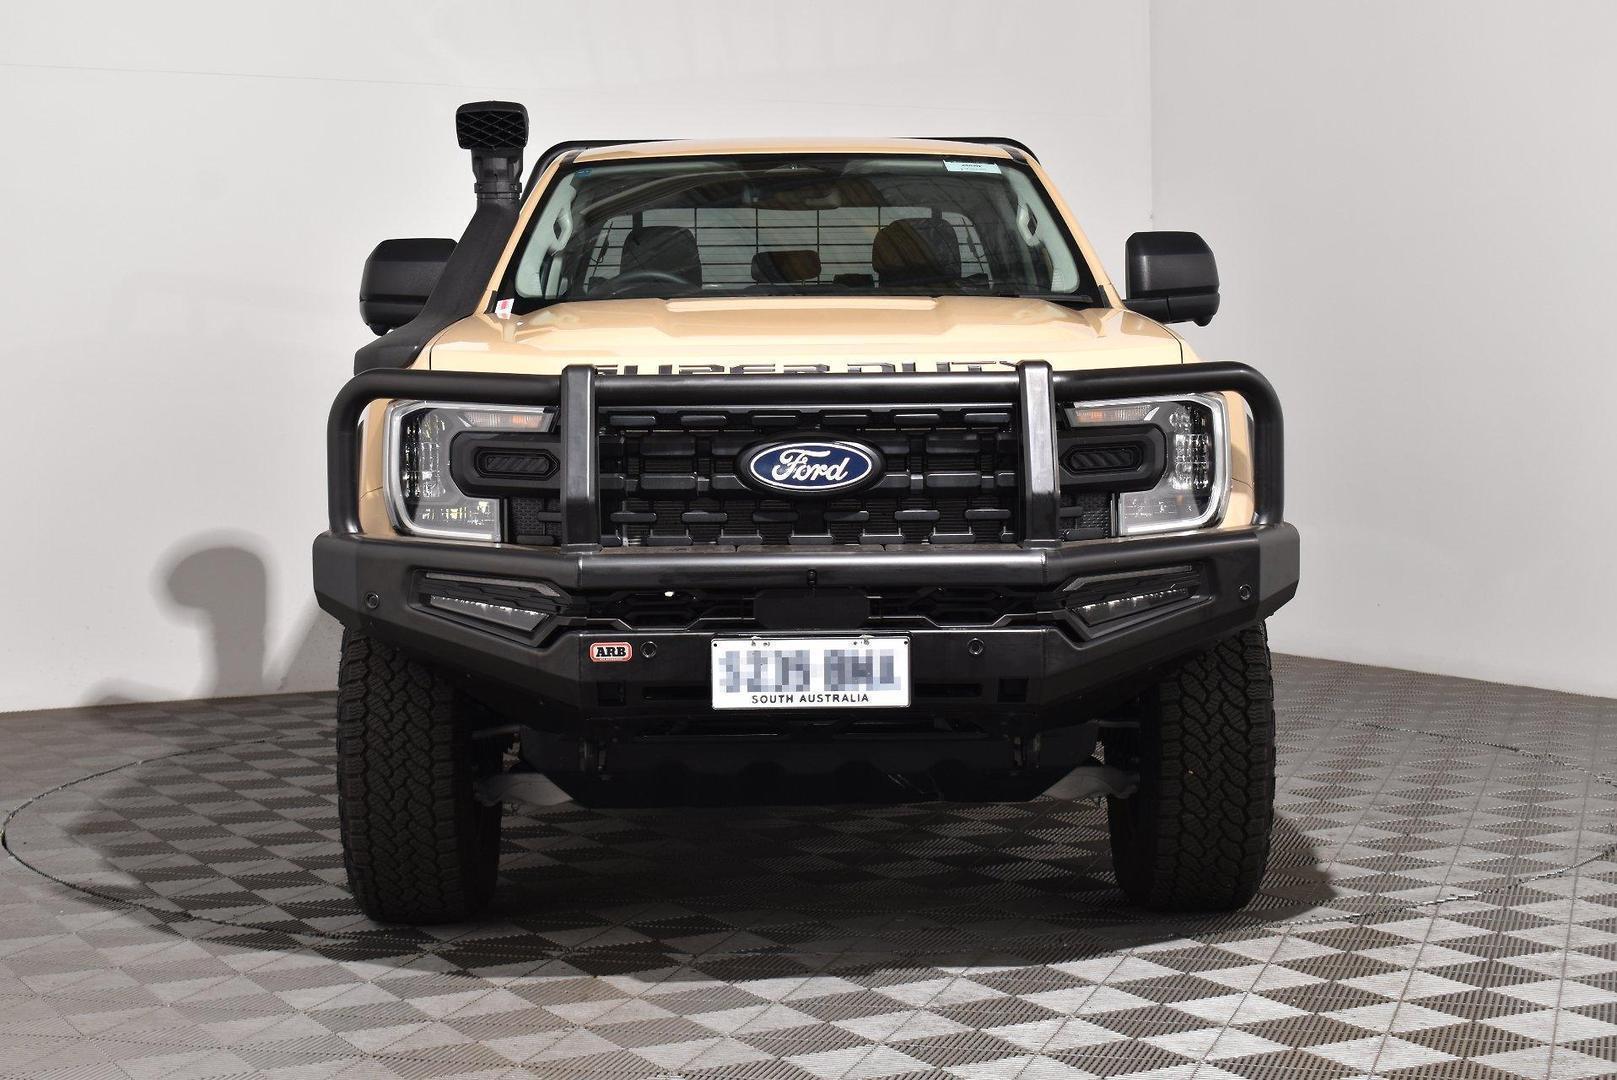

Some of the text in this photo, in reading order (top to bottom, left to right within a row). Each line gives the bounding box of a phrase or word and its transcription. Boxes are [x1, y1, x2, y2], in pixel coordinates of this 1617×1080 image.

[771, 448, 851, 481] Ford
[596, 646, 627, 658] ARB
[751, 693, 870, 704] SOUTH AUSTRALIA
